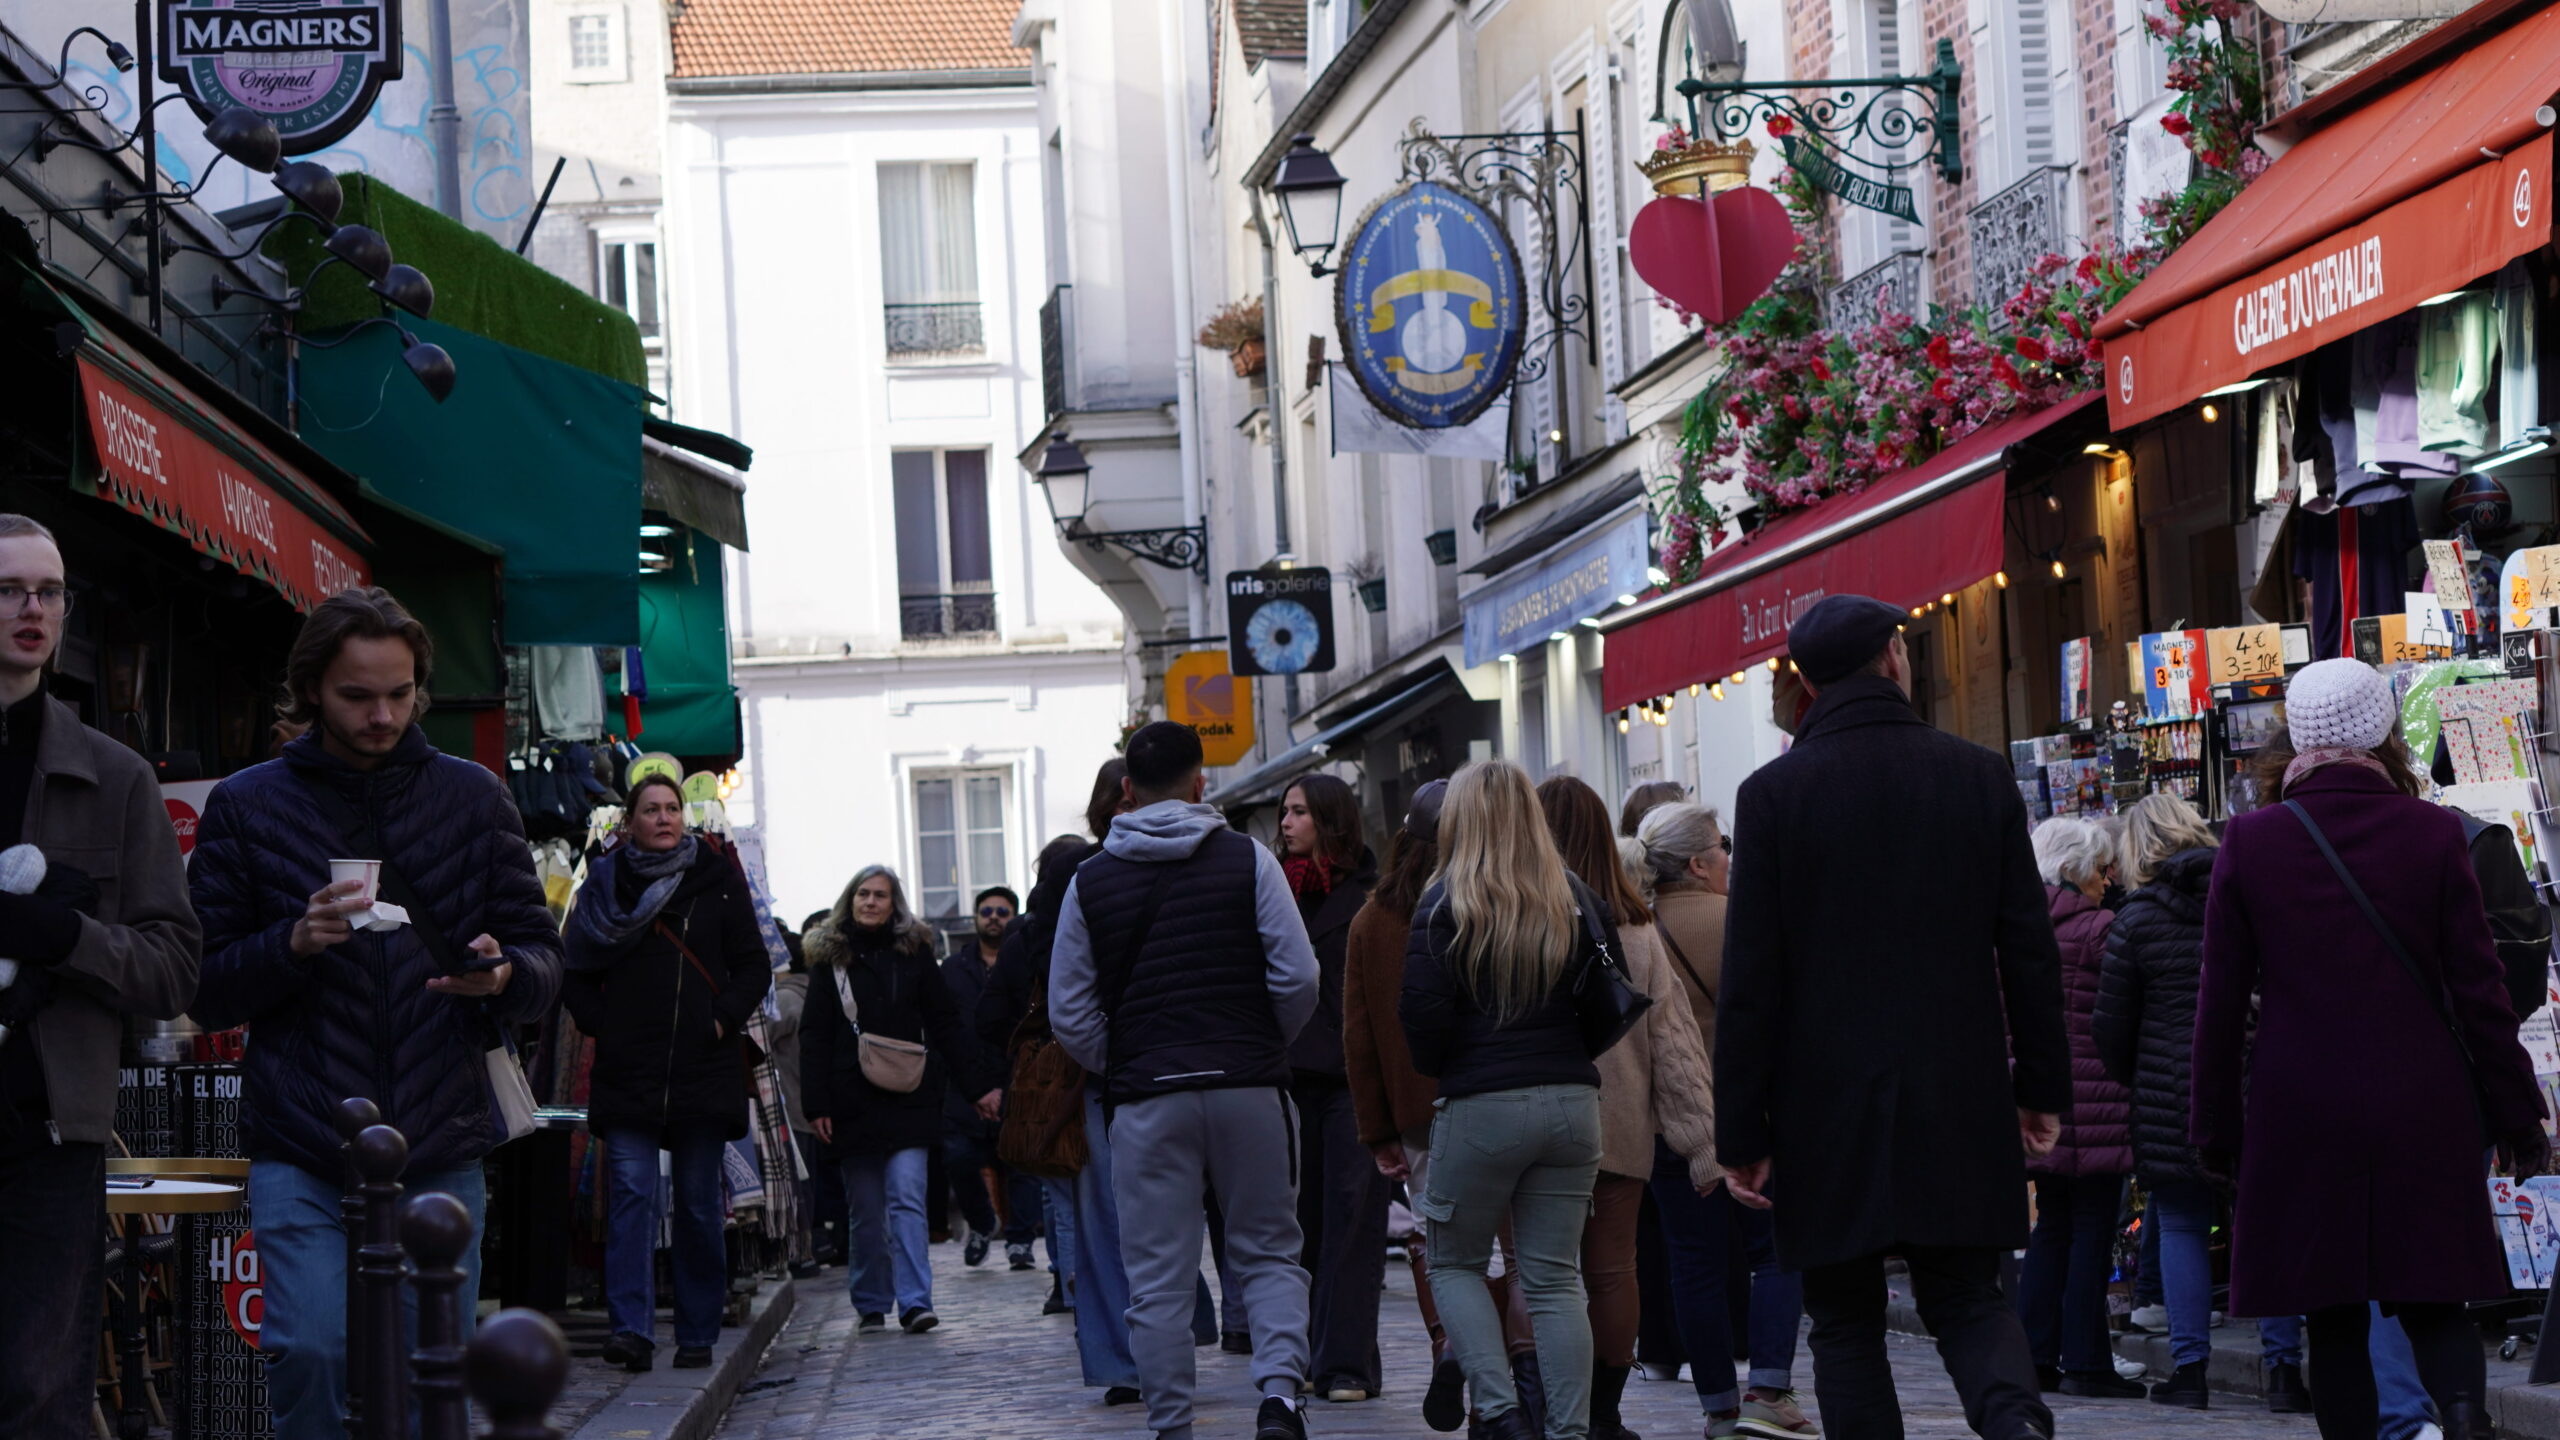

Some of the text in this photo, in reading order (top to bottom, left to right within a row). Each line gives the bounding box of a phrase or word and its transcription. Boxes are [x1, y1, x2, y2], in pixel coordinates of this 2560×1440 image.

[182, 14, 374, 49] MAGNERS
[239, 69, 316, 96] Original
[2516, 180, 2530, 212] 42
[2234, 235, 2384, 356] GALERIE DU CHEVALIER
[98, 389, 168, 486] BRASSERIE
[2153, 639, 2195, 653] MAGNETS
[2236, 631, 2252, 655] 4
[2172, 650, 2182, 666] 4
[2224, 656, 2241, 678] 3
[2257, 651, 2280, 673] 10€
[2156, 668, 2166, 686] 3
[144, 1066, 167, 1087] DE
[193, 1075, 210, 1099] EL
[145, 1086, 169, 1109] DE
[146, 1108, 170, 1131] DE
[193, 1098, 211, 1125] EL
[146, 1130, 170, 1153] DE
[193, 1124, 211, 1150] EL
[191, 1355, 208, 1381] EL
[210, 1356, 248, 1382] RON
[191, 1381, 208, 1406] EL
[210, 1382, 248, 1408] RON
[190, 1407, 207, 1432] EL
[210, 1408, 248, 1434] RON
